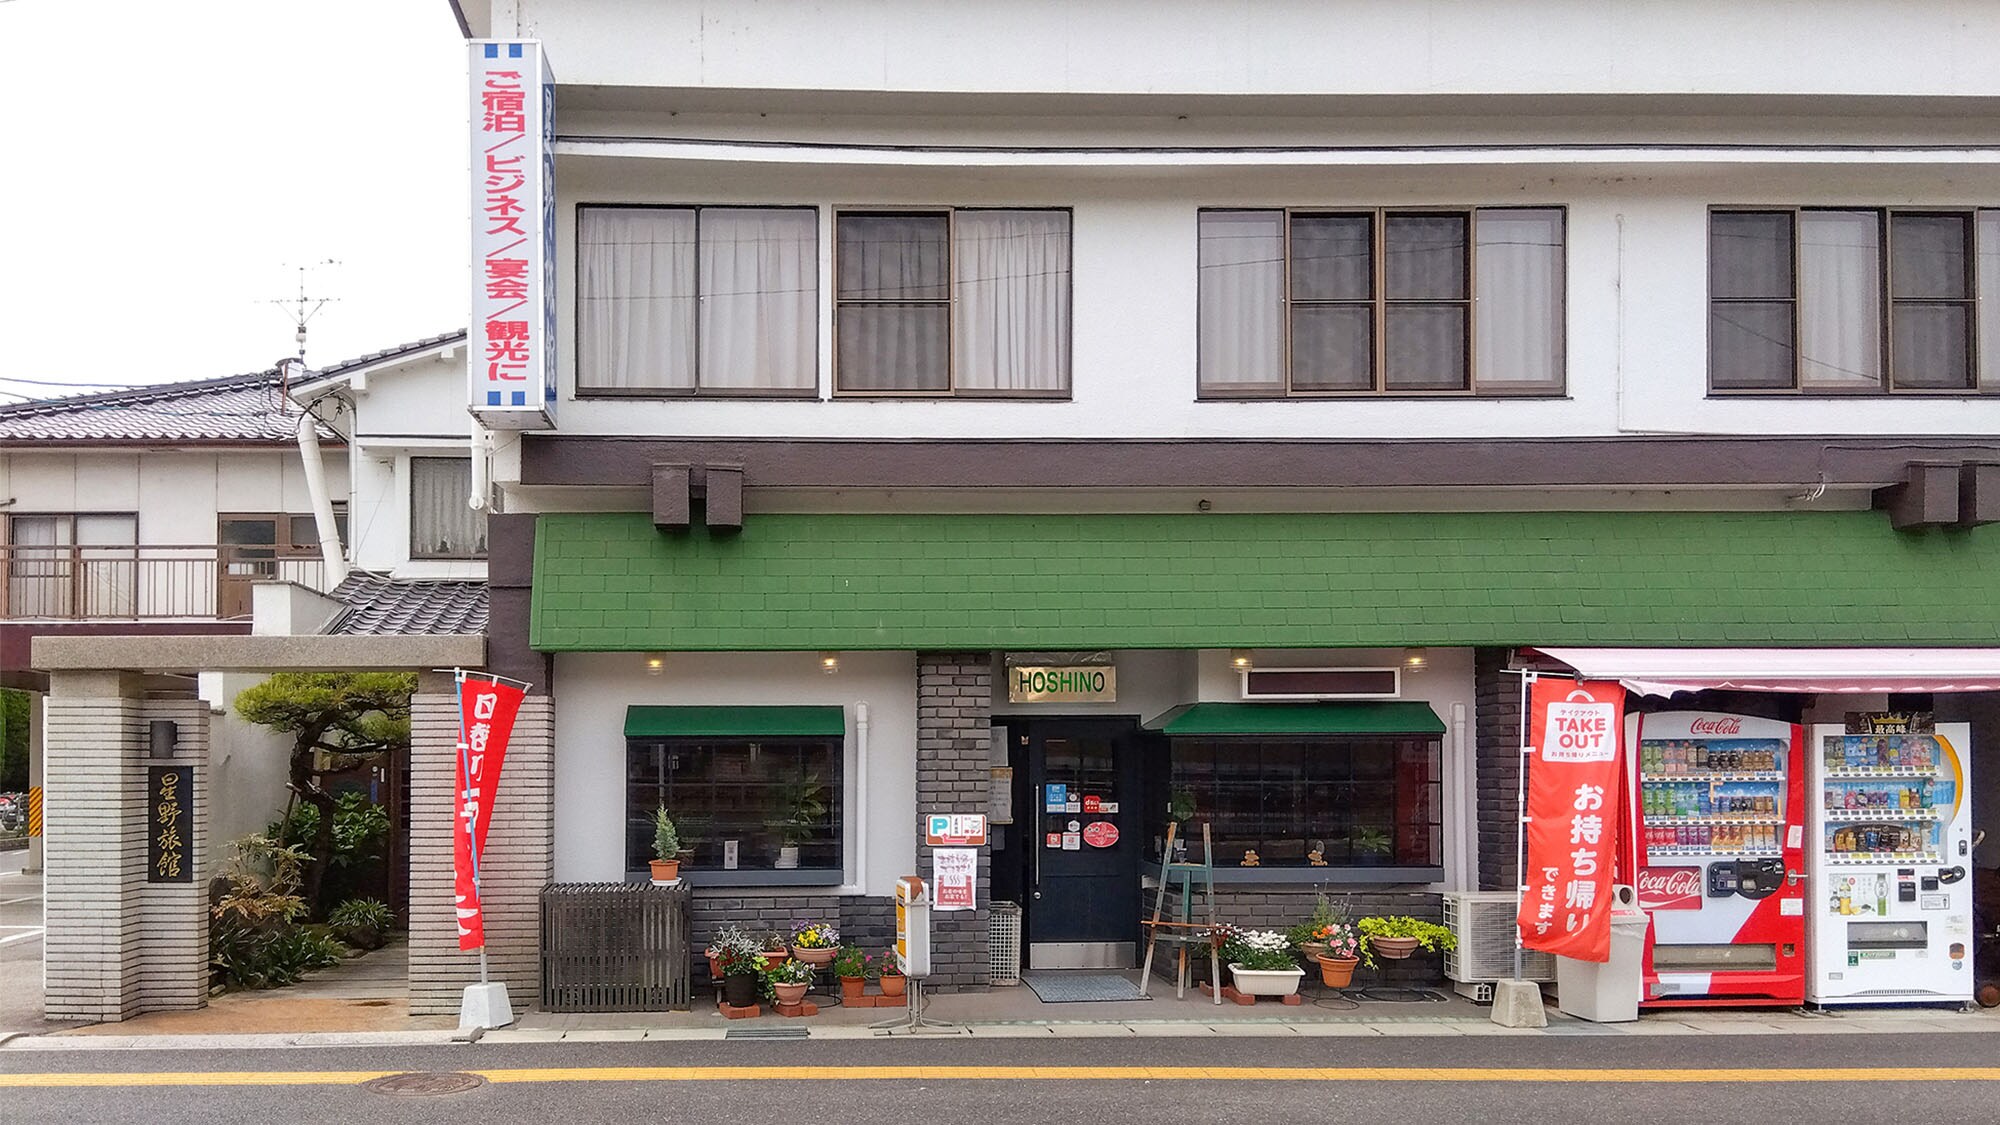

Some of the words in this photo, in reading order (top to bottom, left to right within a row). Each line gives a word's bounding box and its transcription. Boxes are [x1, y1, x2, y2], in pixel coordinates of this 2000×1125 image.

[1019, 671, 1105, 693] HOSHINO
[1560, 709, 1600, 717] テイクアウト
[1555, 717, 1606, 733] TAKE
[1690, 717, 1743, 734] Coca-Cola
[1559, 733, 1604, 749] OUT
[157, 772, 182, 878] 星野旅館
[932, 818, 948, 834] P
[1565, 783, 1604, 937] お持ち帰り
[1535, 866, 1560, 935] できます
